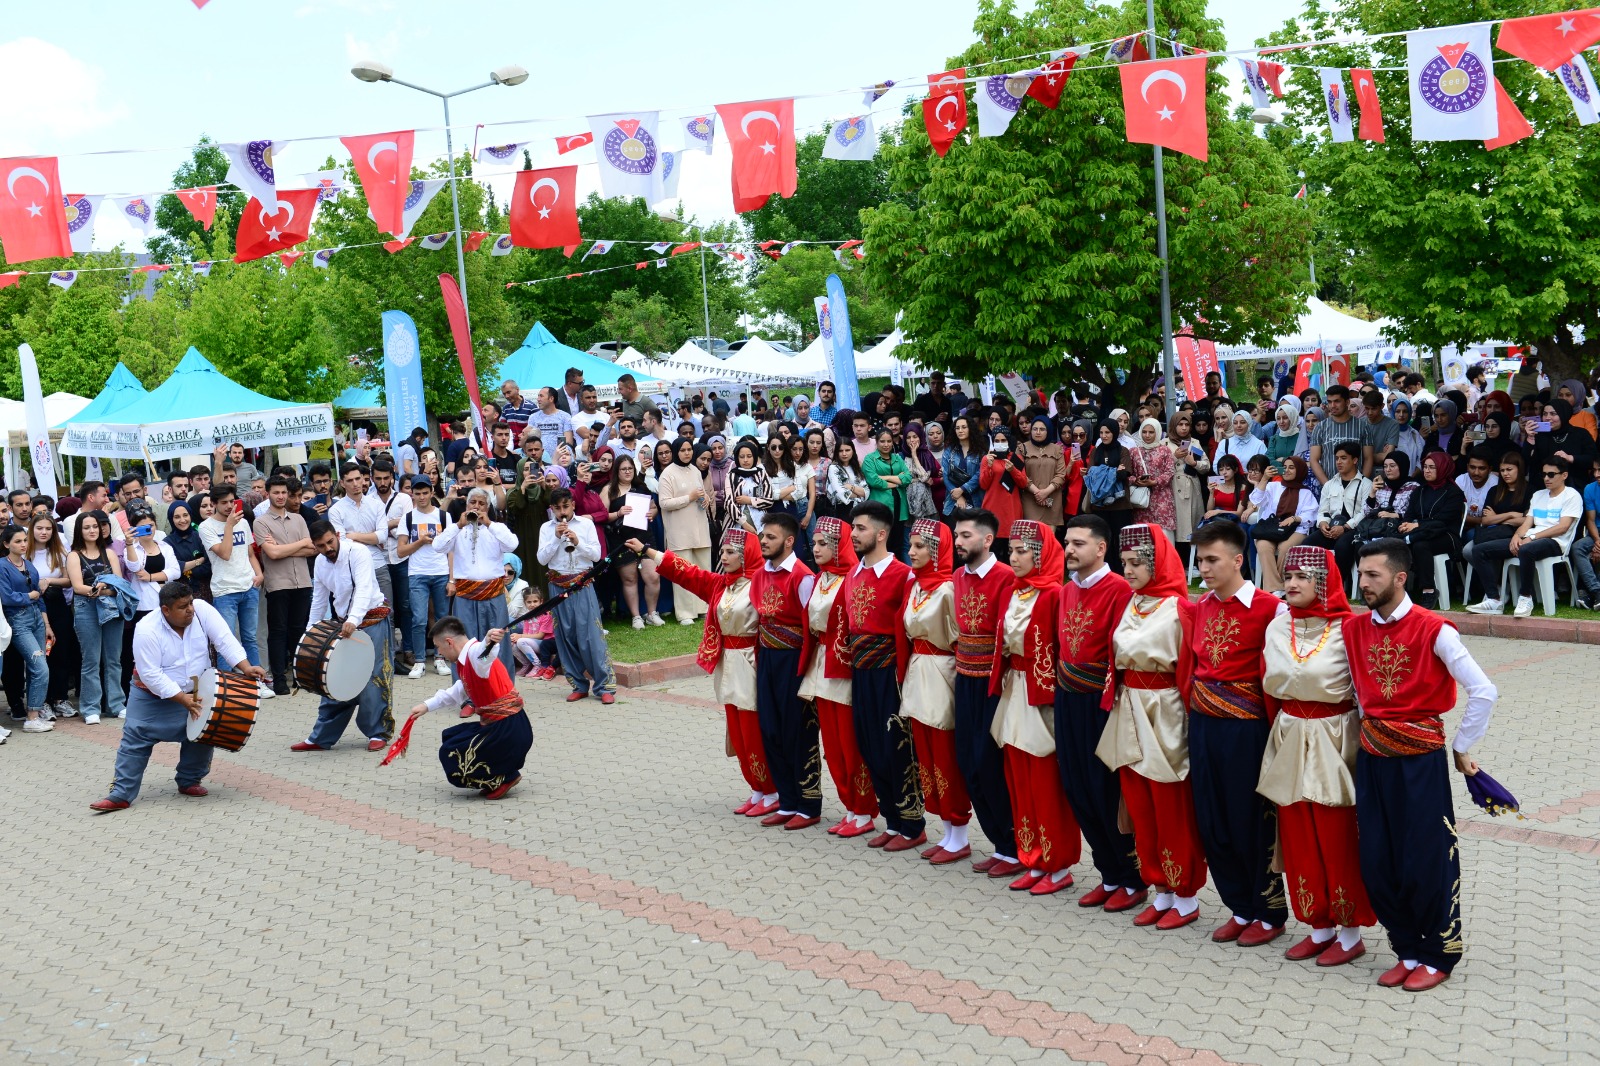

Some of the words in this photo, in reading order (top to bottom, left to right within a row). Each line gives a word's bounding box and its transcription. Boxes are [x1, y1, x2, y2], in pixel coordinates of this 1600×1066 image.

[212, 420, 266, 438] ARABICA
[275, 414, 327, 431] ARABICA
[147, 428, 203, 446] ARABICA
[244, 432, 266, 440] HOUSE
[274, 428, 301, 438] COFFEE
[305, 426, 327, 434] HOUSE
[148, 444, 176, 455] COFFEE
[180, 440, 203, 450] HOUSE
